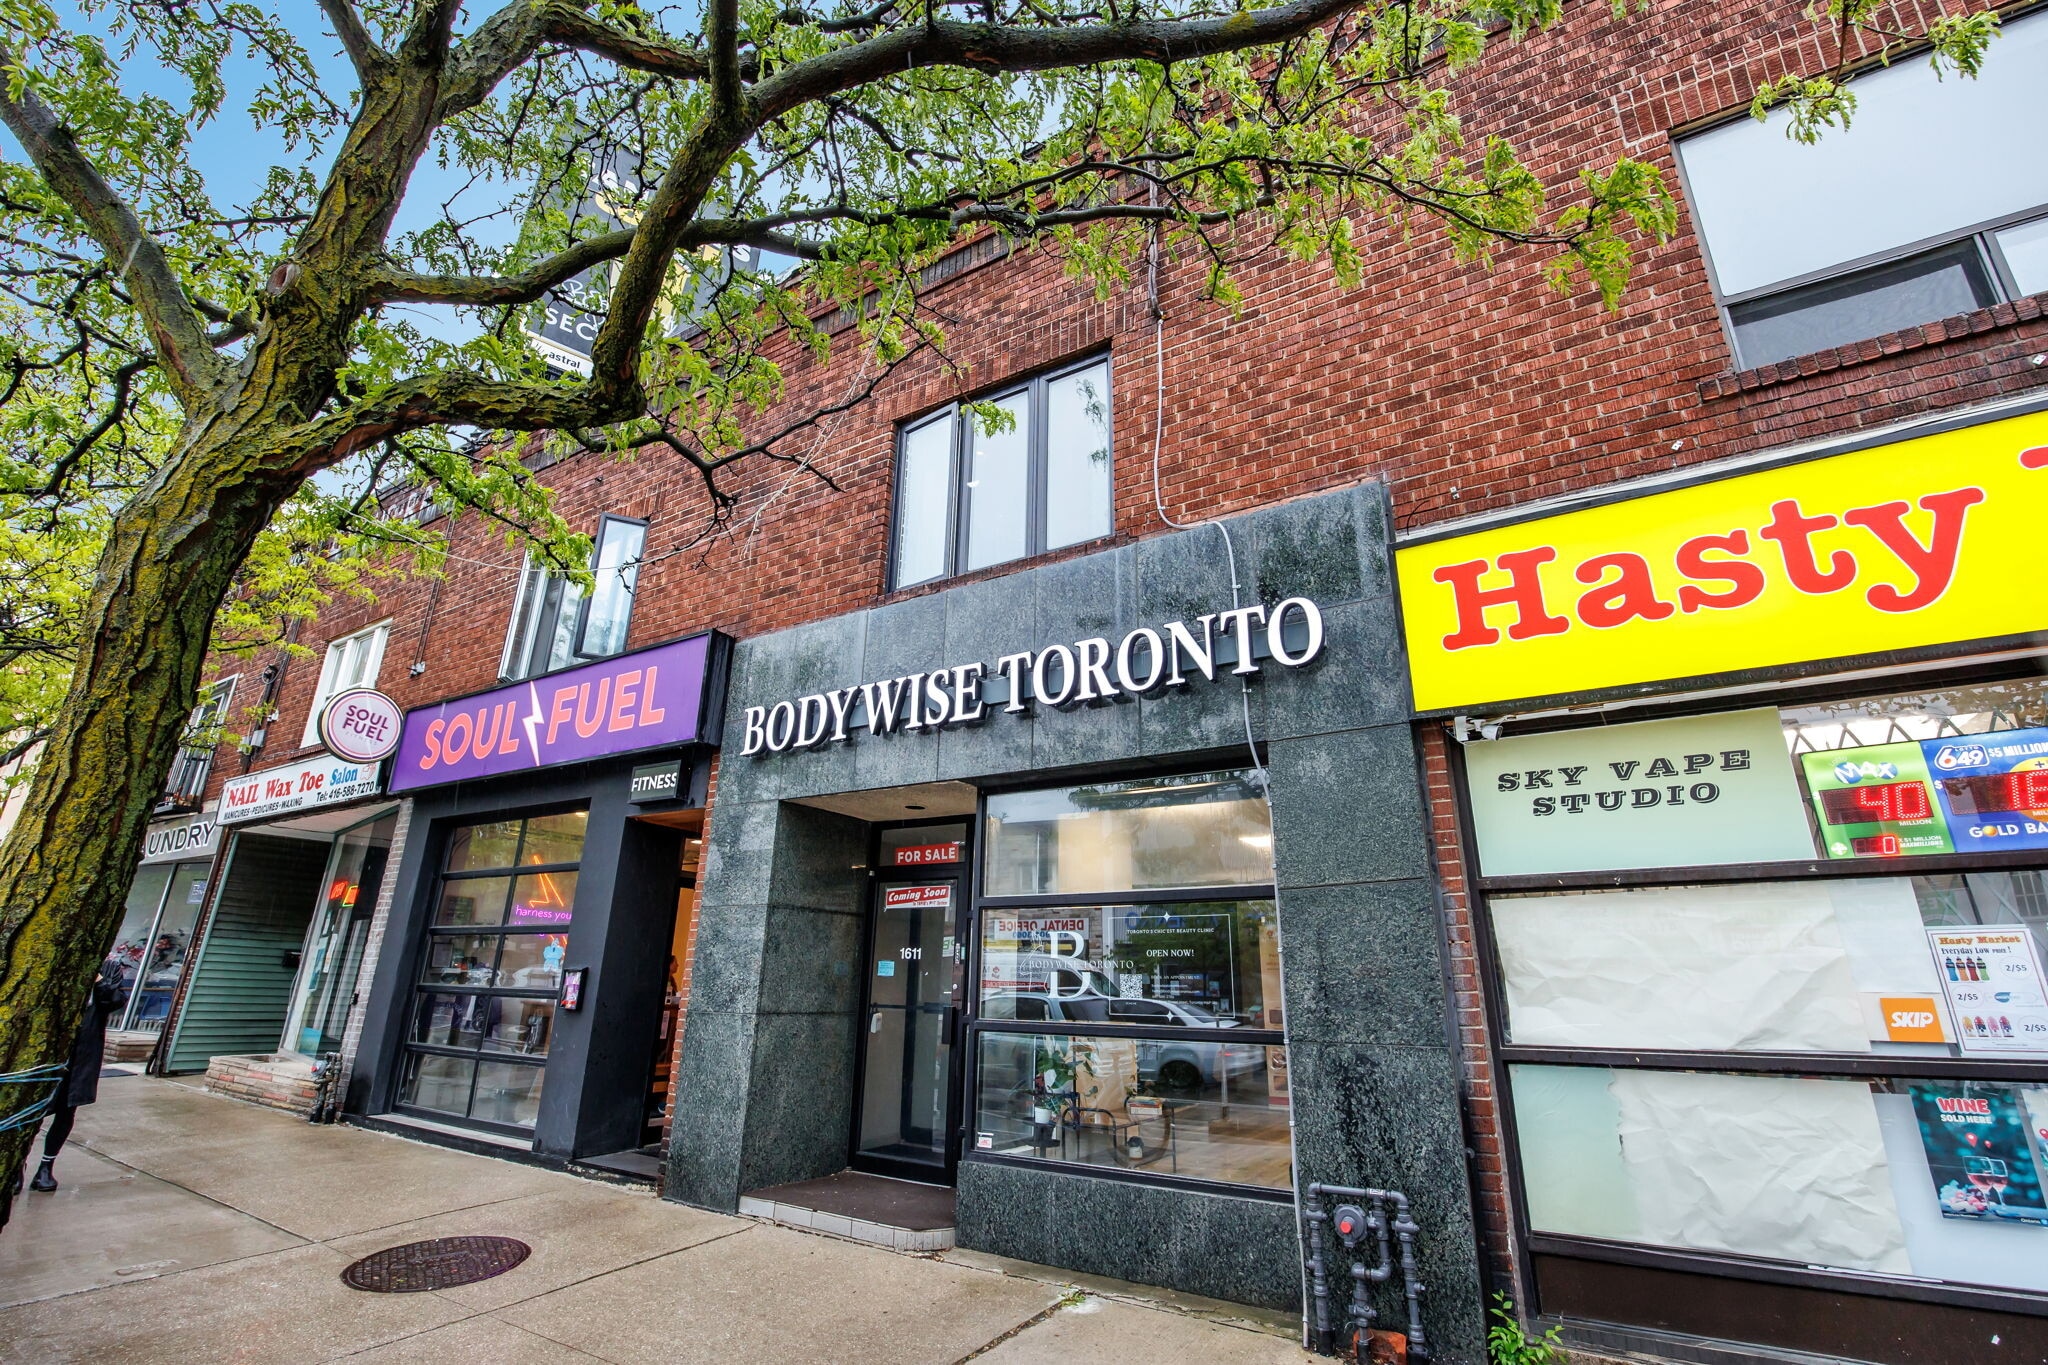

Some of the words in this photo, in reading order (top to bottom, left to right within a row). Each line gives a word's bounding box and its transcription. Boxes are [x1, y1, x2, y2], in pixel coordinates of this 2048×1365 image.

[1433, 486, 1985, 652] Hasty
[739, 661, 985, 757] BODYWISE
[997, 597, 1326, 714] TORONTO
[346, 704, 388, 730] SOUL
[419, 701, 520, 770] SOUL
[546, 666, 665, 745] FUEL
[342, 717, 384, 742] FUEL
[1497, 764, 1588, 793] SKY
[1608, 748, 1752, 782] VAPE
[1834, 761, 1896, 784] MAX
[226, 783, 260, 809] NAIL
[265, 777, 294, 802] Wax
[298, 771, 324, 793] Toe
[329, 766, 359, 787] Salon
[631, 772, 678, 793] FITNESS
[1532, 781, 1721, 817] STUDIO
[1860, 782, 1926, 819] 40
[143, 820, 216, 858] UNDRY
[897, 850, 921, 864] FOR
[925, 847, 956, 861] SALE
[888, 890, 921, 902] Coming
[923, 887, 946, 898] Soon
[515, 905, 553, 919] harness
[1939, 937, 1973, 946] Hasty
[1977, 935, 2021, 944] Market
[900, 947, 922, 960] 1611
[1146, 949, 1169, 957] OPEN
[1170, 949, 1194, 957] NOW!
[1891, 1011, 1934, 1028] SKIP
[1937, 1097, 1991, 1115] WINE
[1940, 1114, 1965, 1123] SOLD
[1966, 1115, 1993, 1124] HERE
